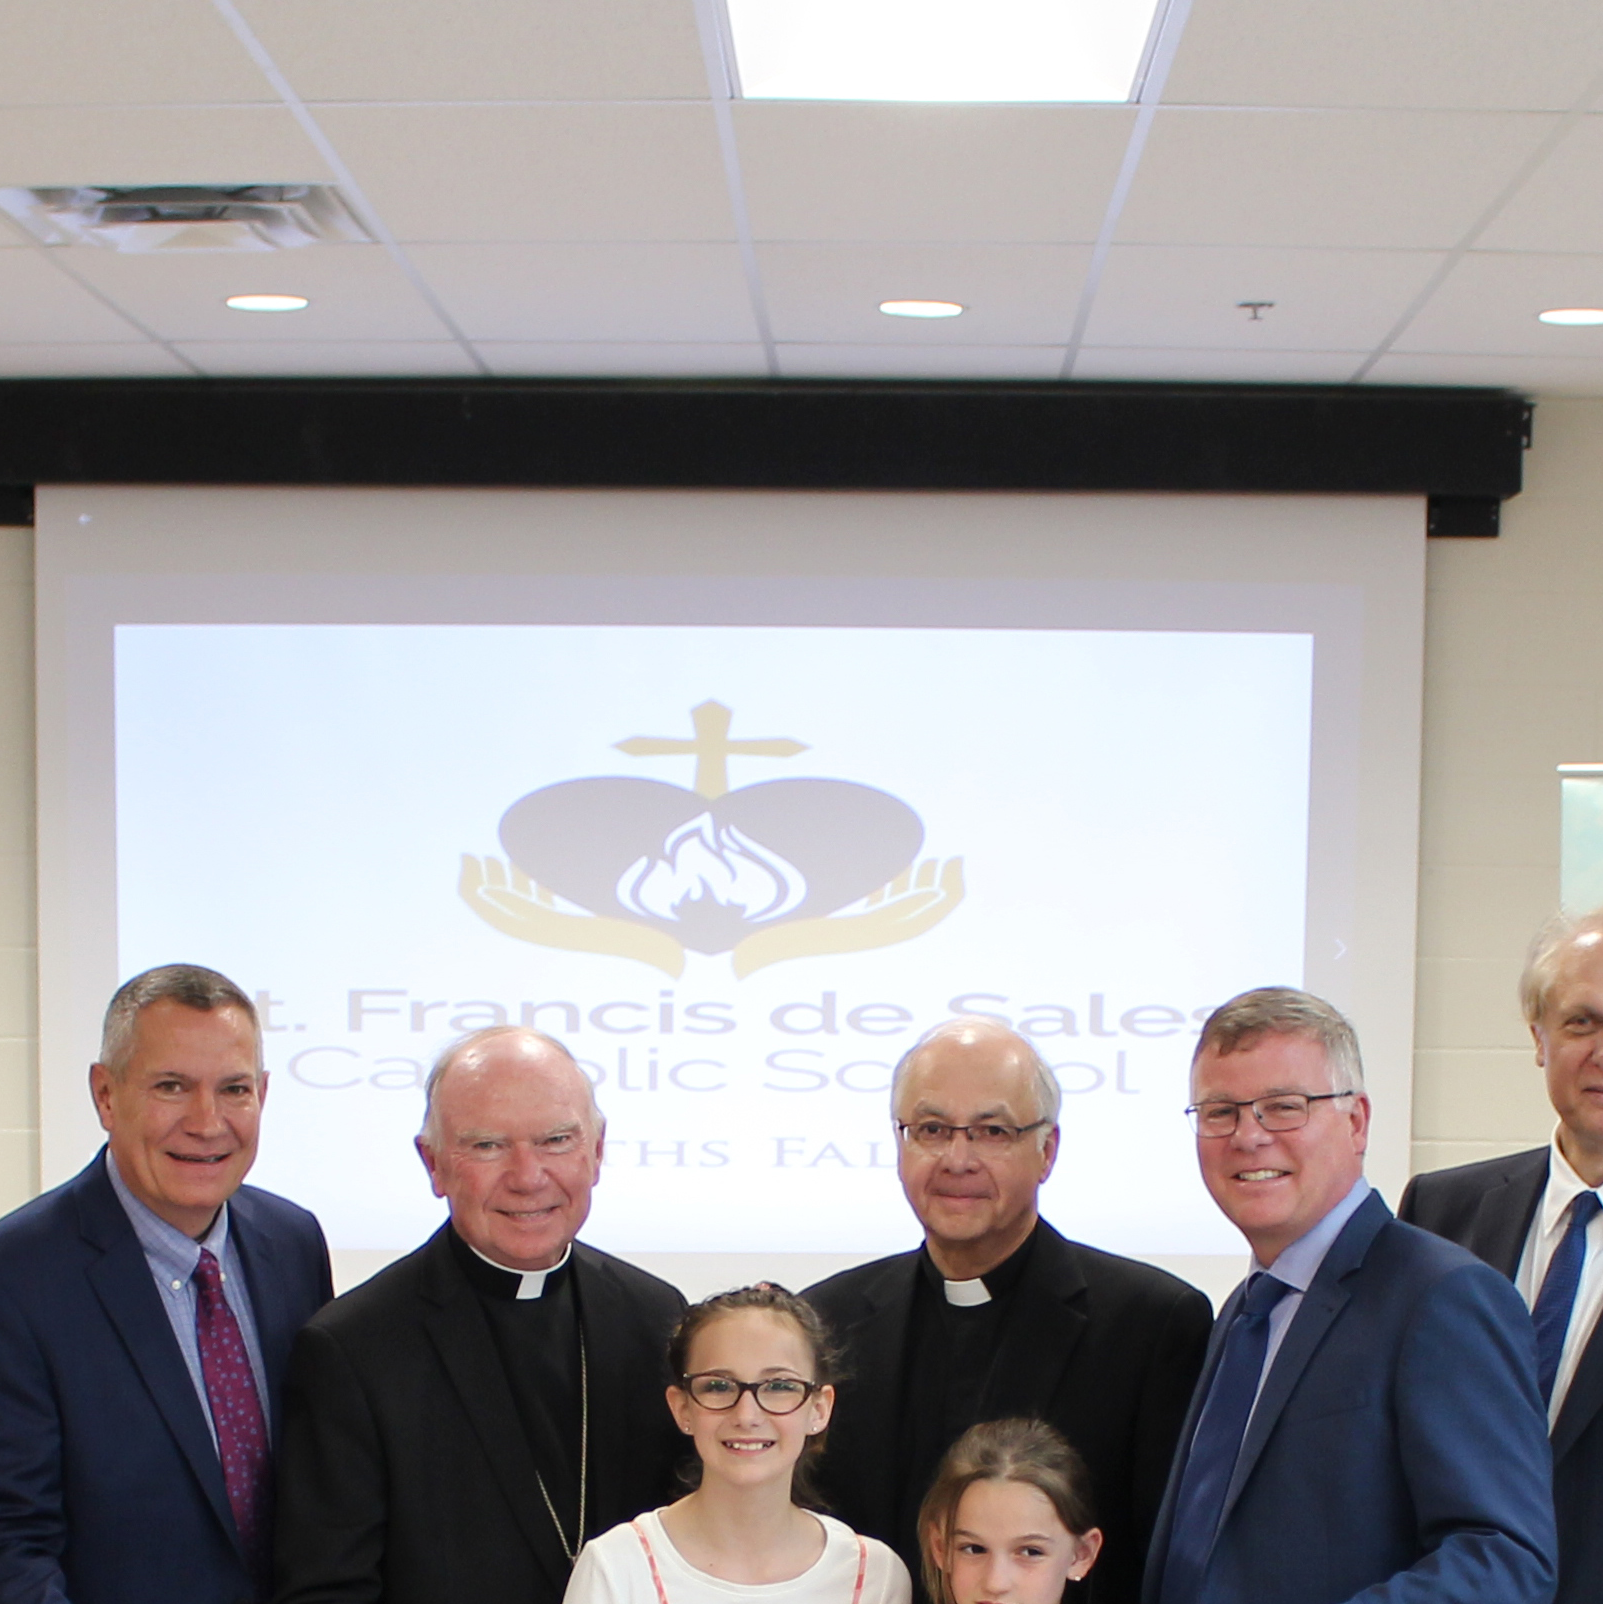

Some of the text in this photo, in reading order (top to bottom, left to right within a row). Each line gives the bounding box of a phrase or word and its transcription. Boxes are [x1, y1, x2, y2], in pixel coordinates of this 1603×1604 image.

[258, 990, 306, 1033] t.
[347, 990, 737, 1035] Francis
[769, 991, 914, 1036] de
[288, 1045, 1141, 1096] Calic Scol
[770, 1136, 899, 1169] FAL
